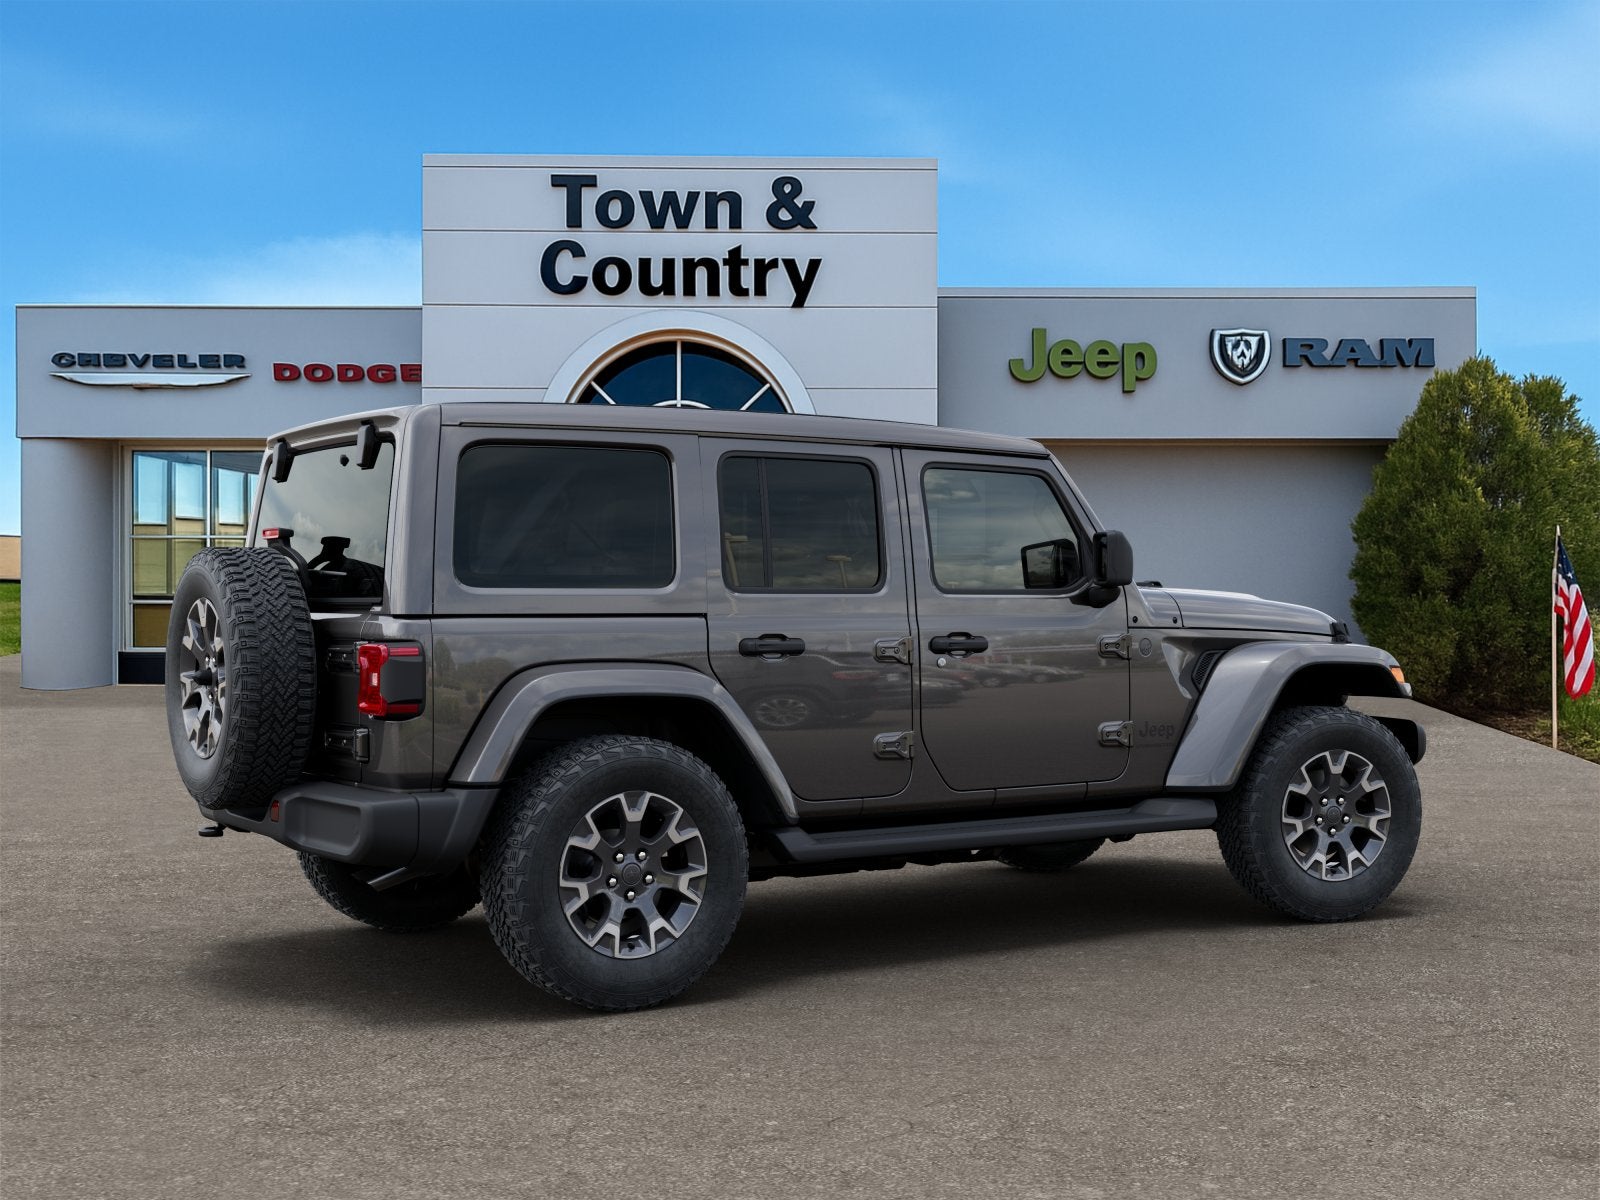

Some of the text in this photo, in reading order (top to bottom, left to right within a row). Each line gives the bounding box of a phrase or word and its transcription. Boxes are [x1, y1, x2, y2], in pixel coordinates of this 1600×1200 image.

[550, 174, 819, 229] Town &
[540, 239, 822, 308] Country
[272, 362, 422, 384] DODGE
[1009, 327, 1158, 393] Jeep
[1282, 337, 1435, 368] RAM
[1138, 720, 1176, 739] Jeep
